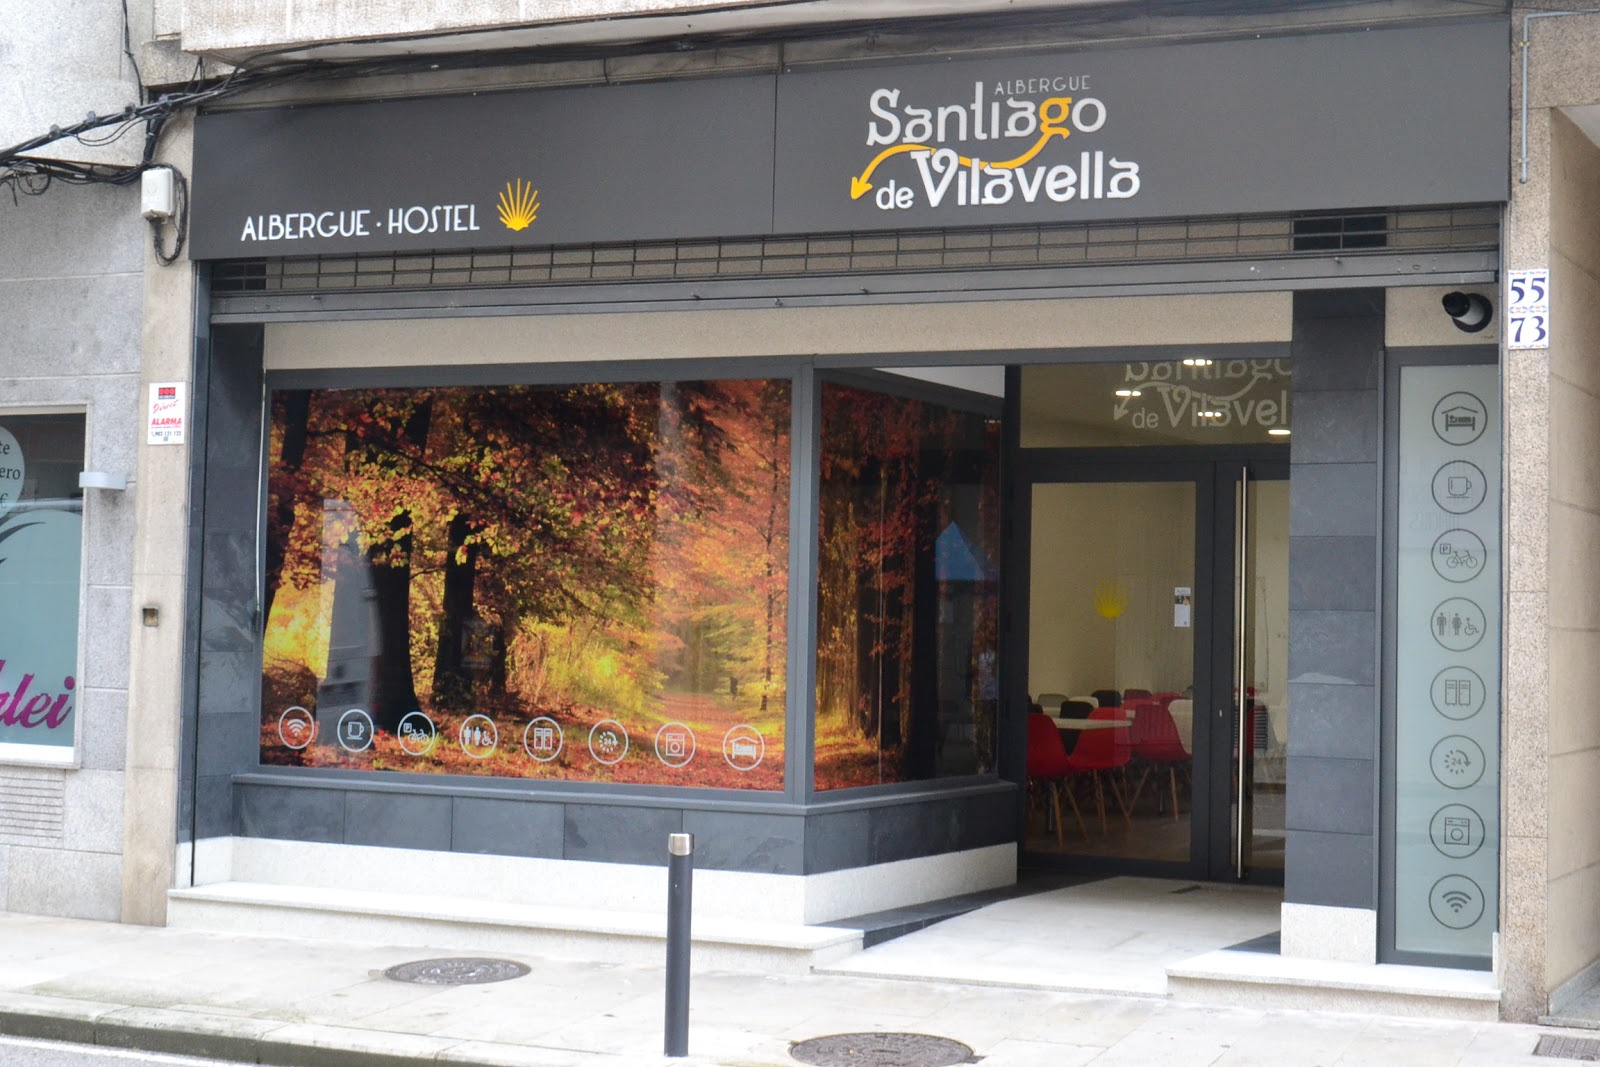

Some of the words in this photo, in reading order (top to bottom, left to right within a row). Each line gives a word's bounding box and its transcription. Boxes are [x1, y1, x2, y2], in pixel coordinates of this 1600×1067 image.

[994, 75, 1091, 96] ALBERGUE
[866, 81, 1107, 147] Santiago
[875, 179, 914, 210] de
[910, 147, 1141, 208] Vilavella
[240, 209, 371, 242] ALBERGUE
[388, 203, 480, 235] HOSTEL
[1510, 276, 1546, 305] 55
[1510, 315, 1547, 343] 73
[151, 417, 182, 425] ALARMA
[1131, 407, 1160, 429] de
